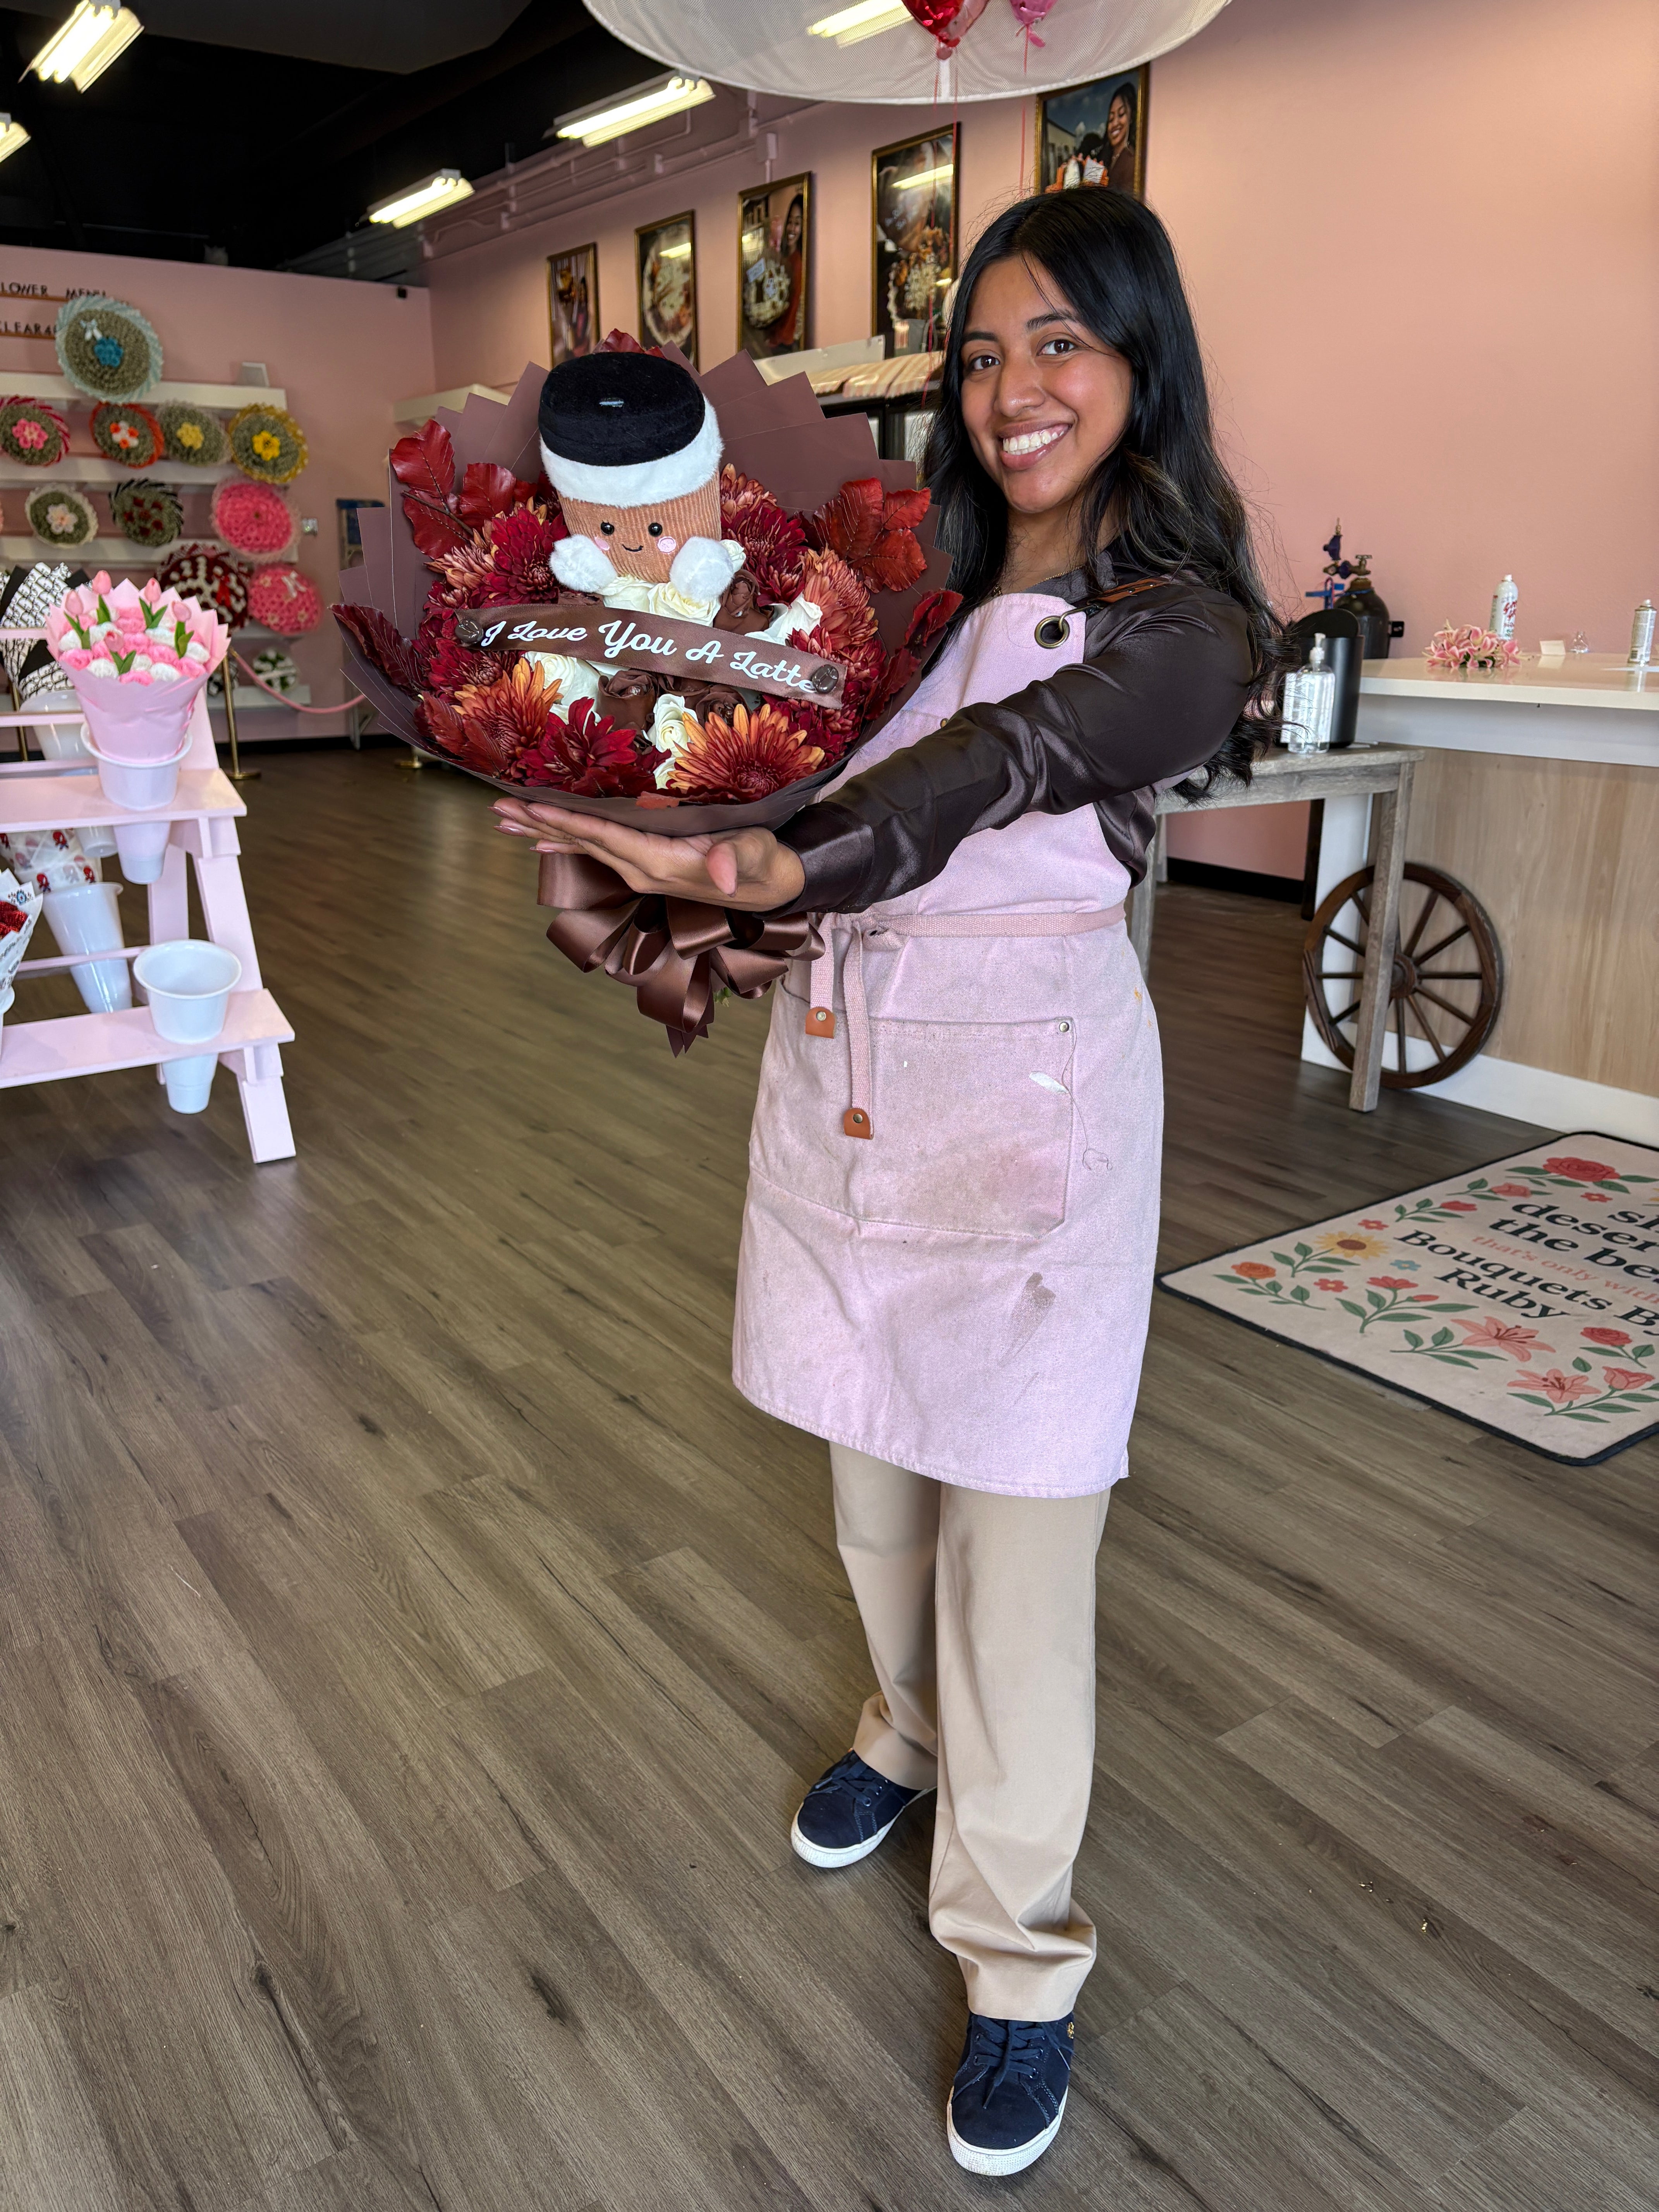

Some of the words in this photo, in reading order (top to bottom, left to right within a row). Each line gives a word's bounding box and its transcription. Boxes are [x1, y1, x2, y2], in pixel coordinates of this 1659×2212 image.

[481, 621, 507, 646] I
[507, 621, 587, 641] Love
[598, 620, 677, 658] You
[685, 640, 724, 664] A
[730, 651, 817, 693] Latte
[1394, 1230, 1613, 1310] Bouquets
[1613, 1305, 1659, 1336] B
[1473, 1236, 1538, 1261] that's
[1541, 1260, 1599, 1281] only
[1489, 1218, 1579, 1252] the
[1583, 1247, 1659, 1284] be
[1434, 1267, 1571, 1319] Ruby
